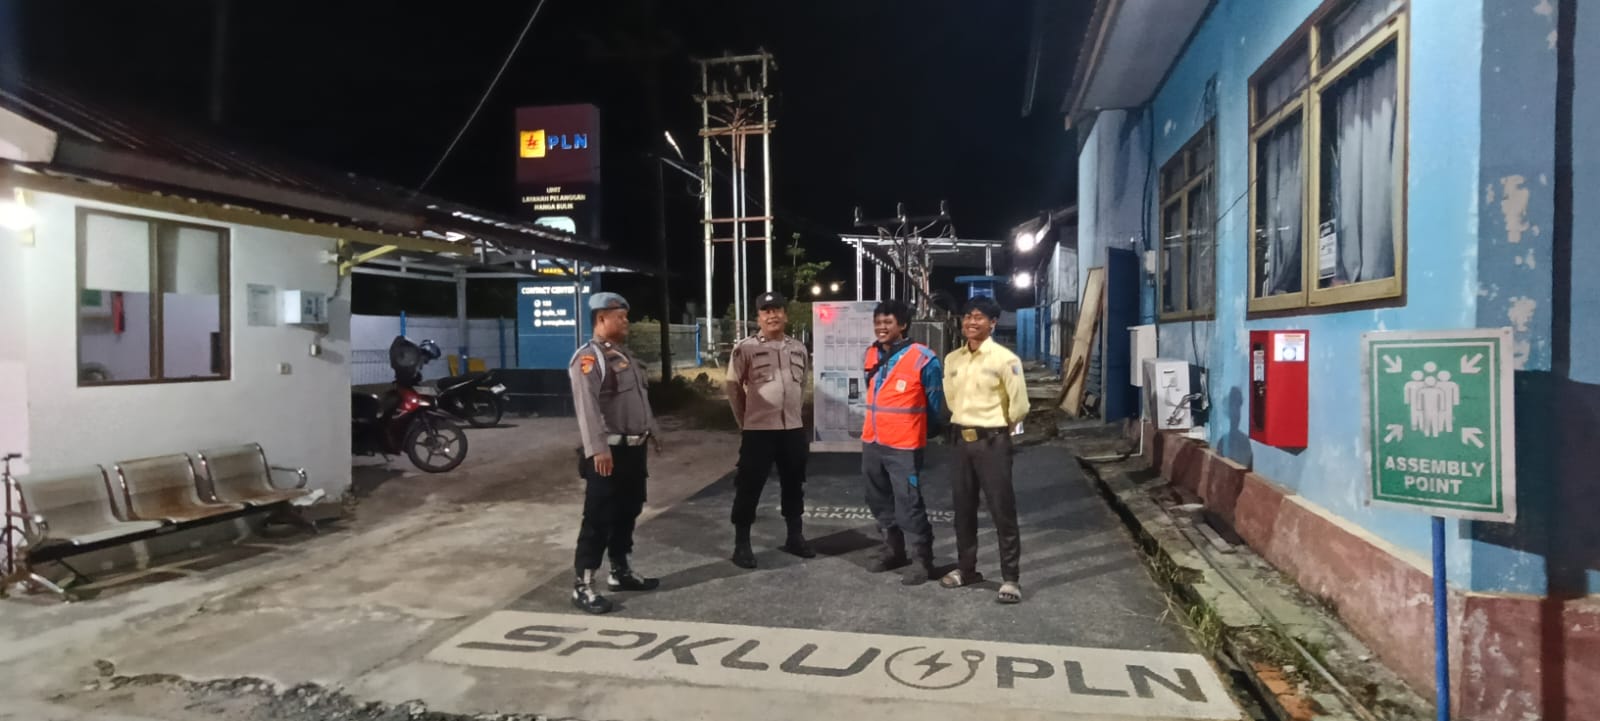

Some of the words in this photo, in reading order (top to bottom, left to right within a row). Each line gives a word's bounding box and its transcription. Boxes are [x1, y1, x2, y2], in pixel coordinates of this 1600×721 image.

[547, 133, 588, 151] PLN
[1384, 456, 1485, 477] ASSEMBLY
[1404, 475, 1462, 495] POINT
[457, 624, 881, 679] SPKLU
[996, 655, 1208, 702] PLN
